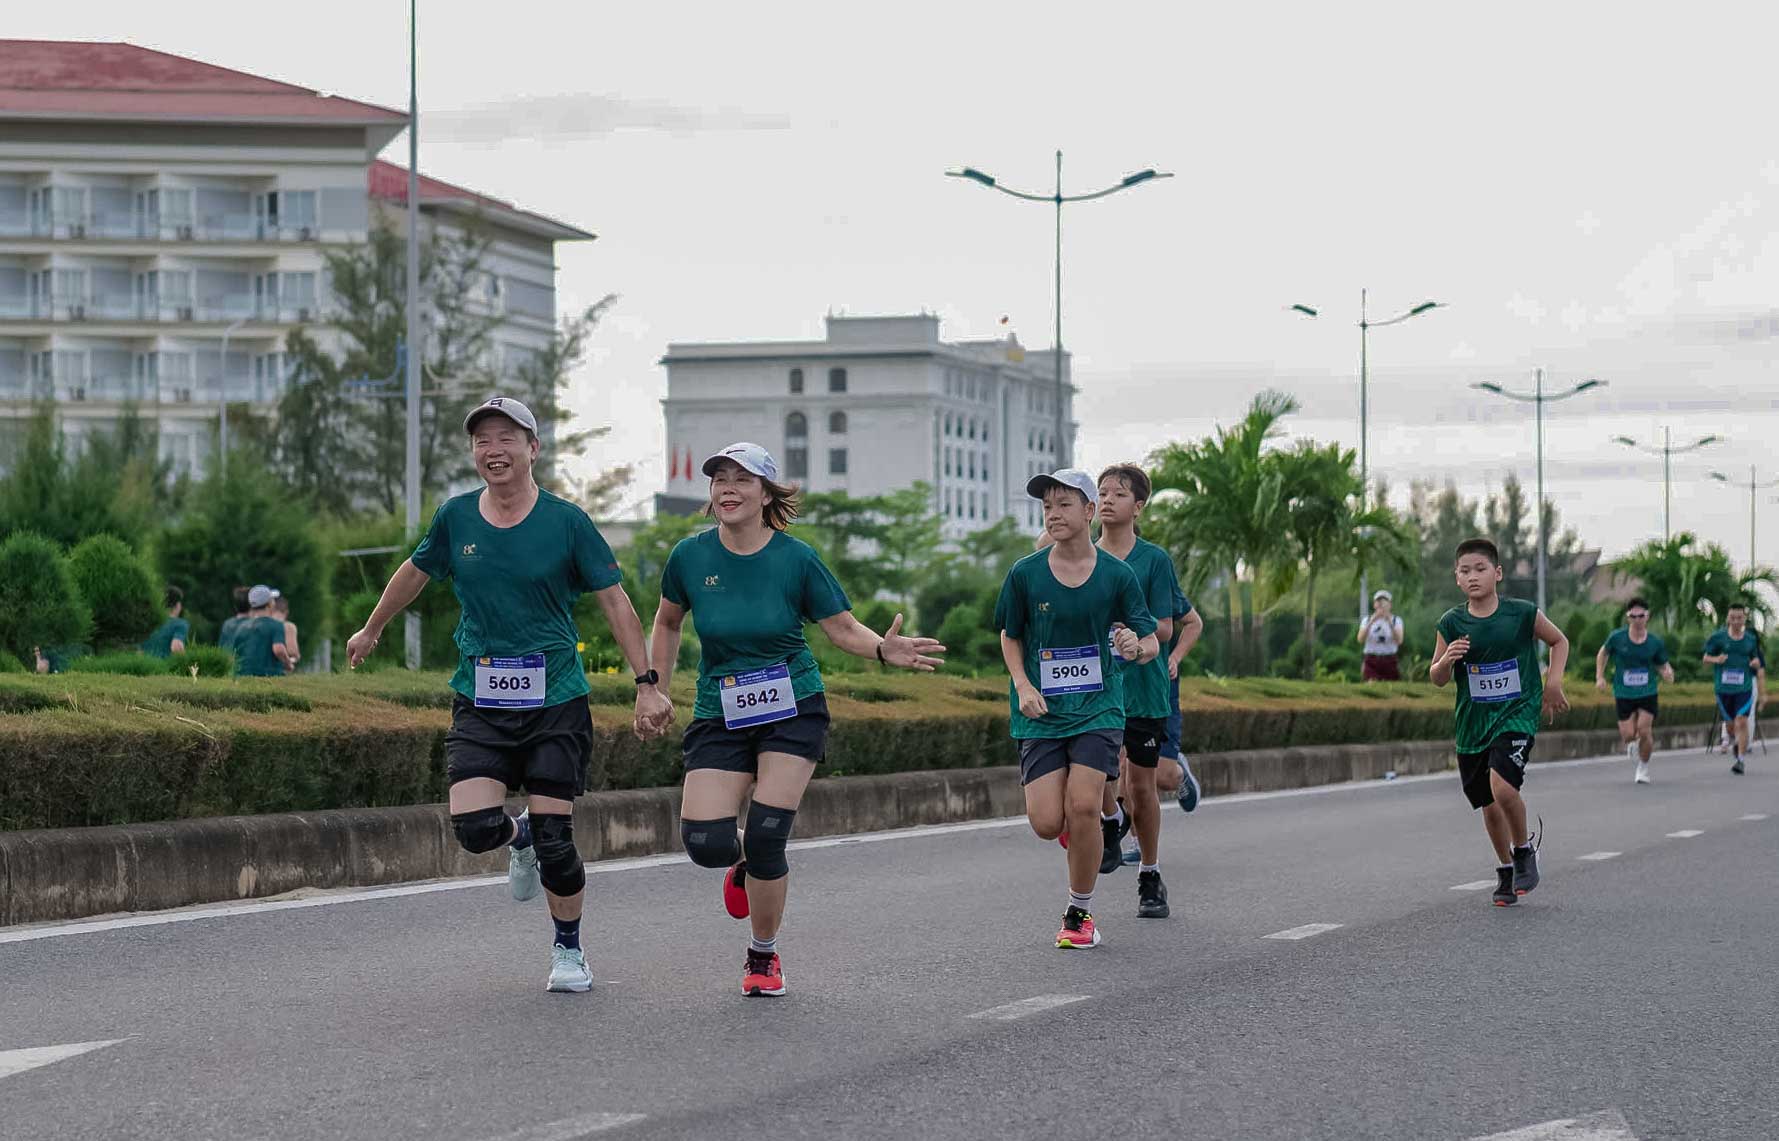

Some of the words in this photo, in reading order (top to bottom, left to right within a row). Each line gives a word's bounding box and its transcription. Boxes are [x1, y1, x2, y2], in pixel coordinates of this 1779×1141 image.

[1052, 664, 1089, 679] 5906
[489, 675, 531, 690] 5603
[1479, 677, 1509, 690] 5157
[736, 688, 780, 709] 5842
